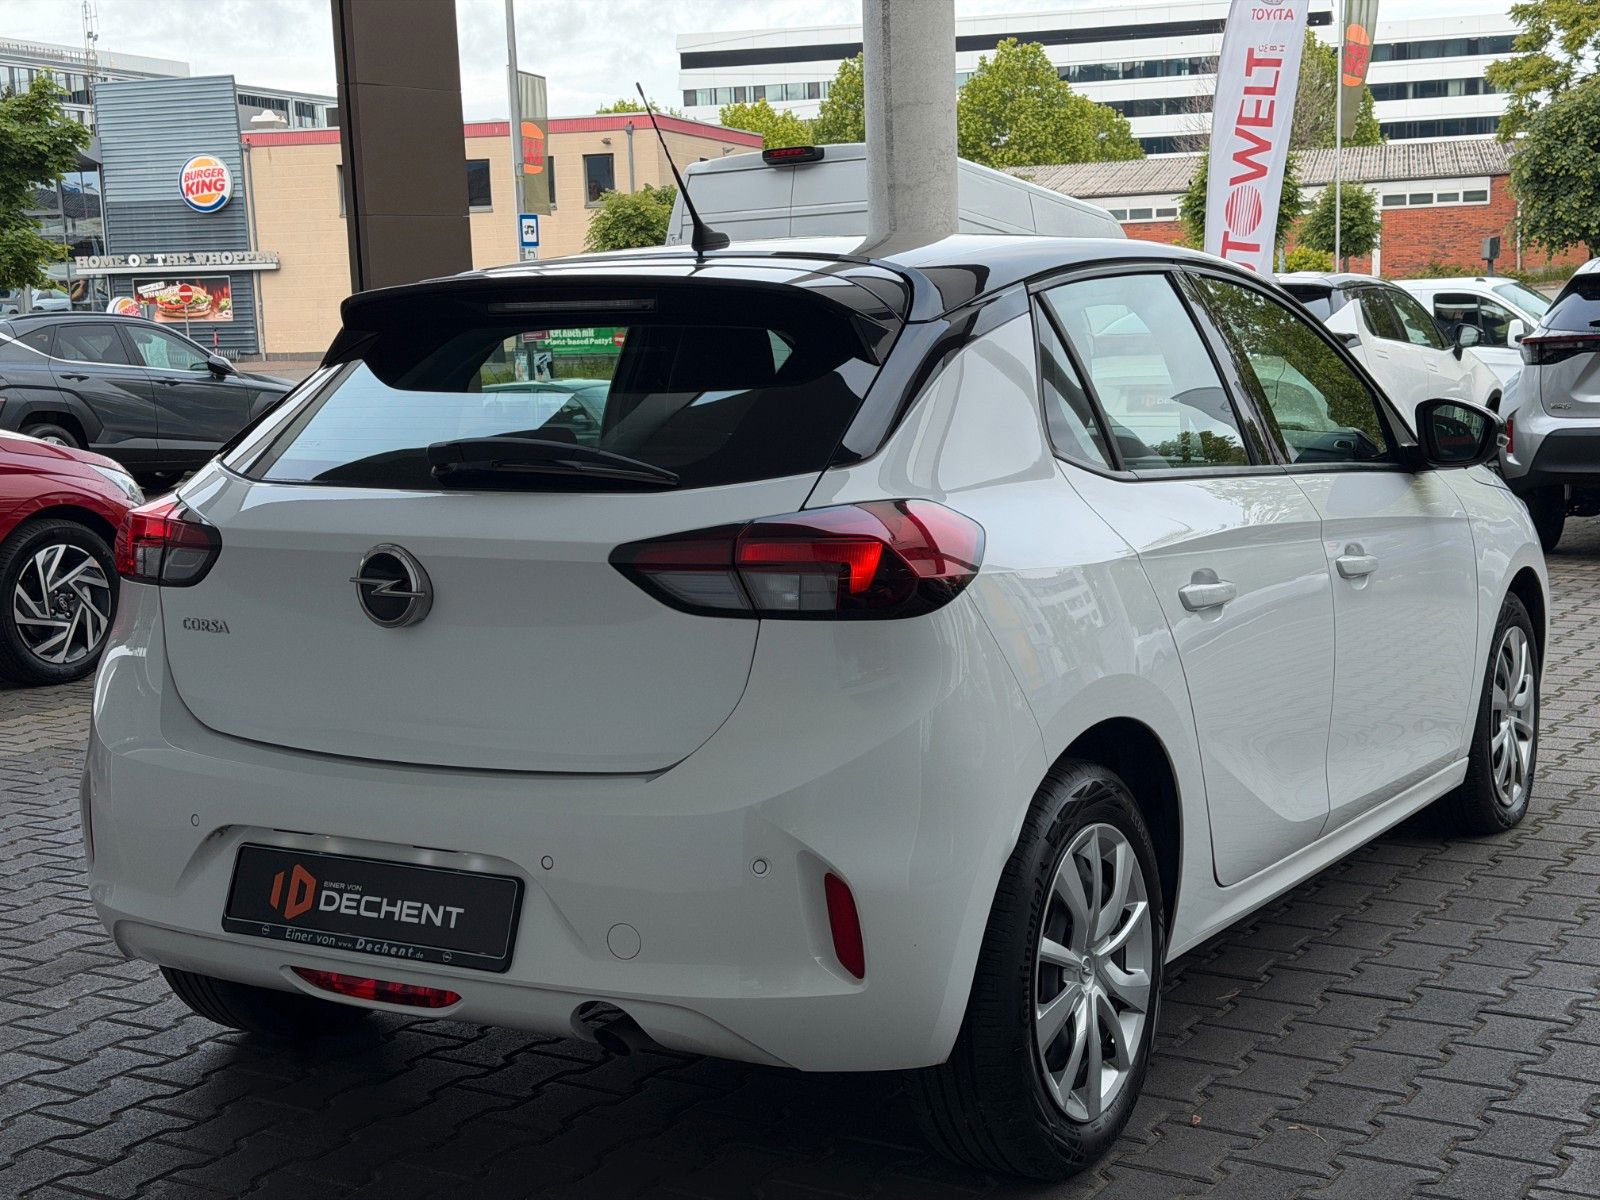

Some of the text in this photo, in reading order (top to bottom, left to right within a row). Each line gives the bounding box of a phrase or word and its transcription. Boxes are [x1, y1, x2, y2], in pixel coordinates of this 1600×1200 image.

[1219, 47, 1283, 271] TOWELT
[184, 168, 225, 182] BURGER
[185, 178, 226, 197] KING
[75, 250, 279, 268] HOME OF THE WHOPPER
[183, 616, 230, 634] CORSA
[323, 880, 363, 892] EINER VON
[318, 890, 465, 929] DECHENT
[285, 927, 313, 943] Einer
[316, 935, 336, 946] von
